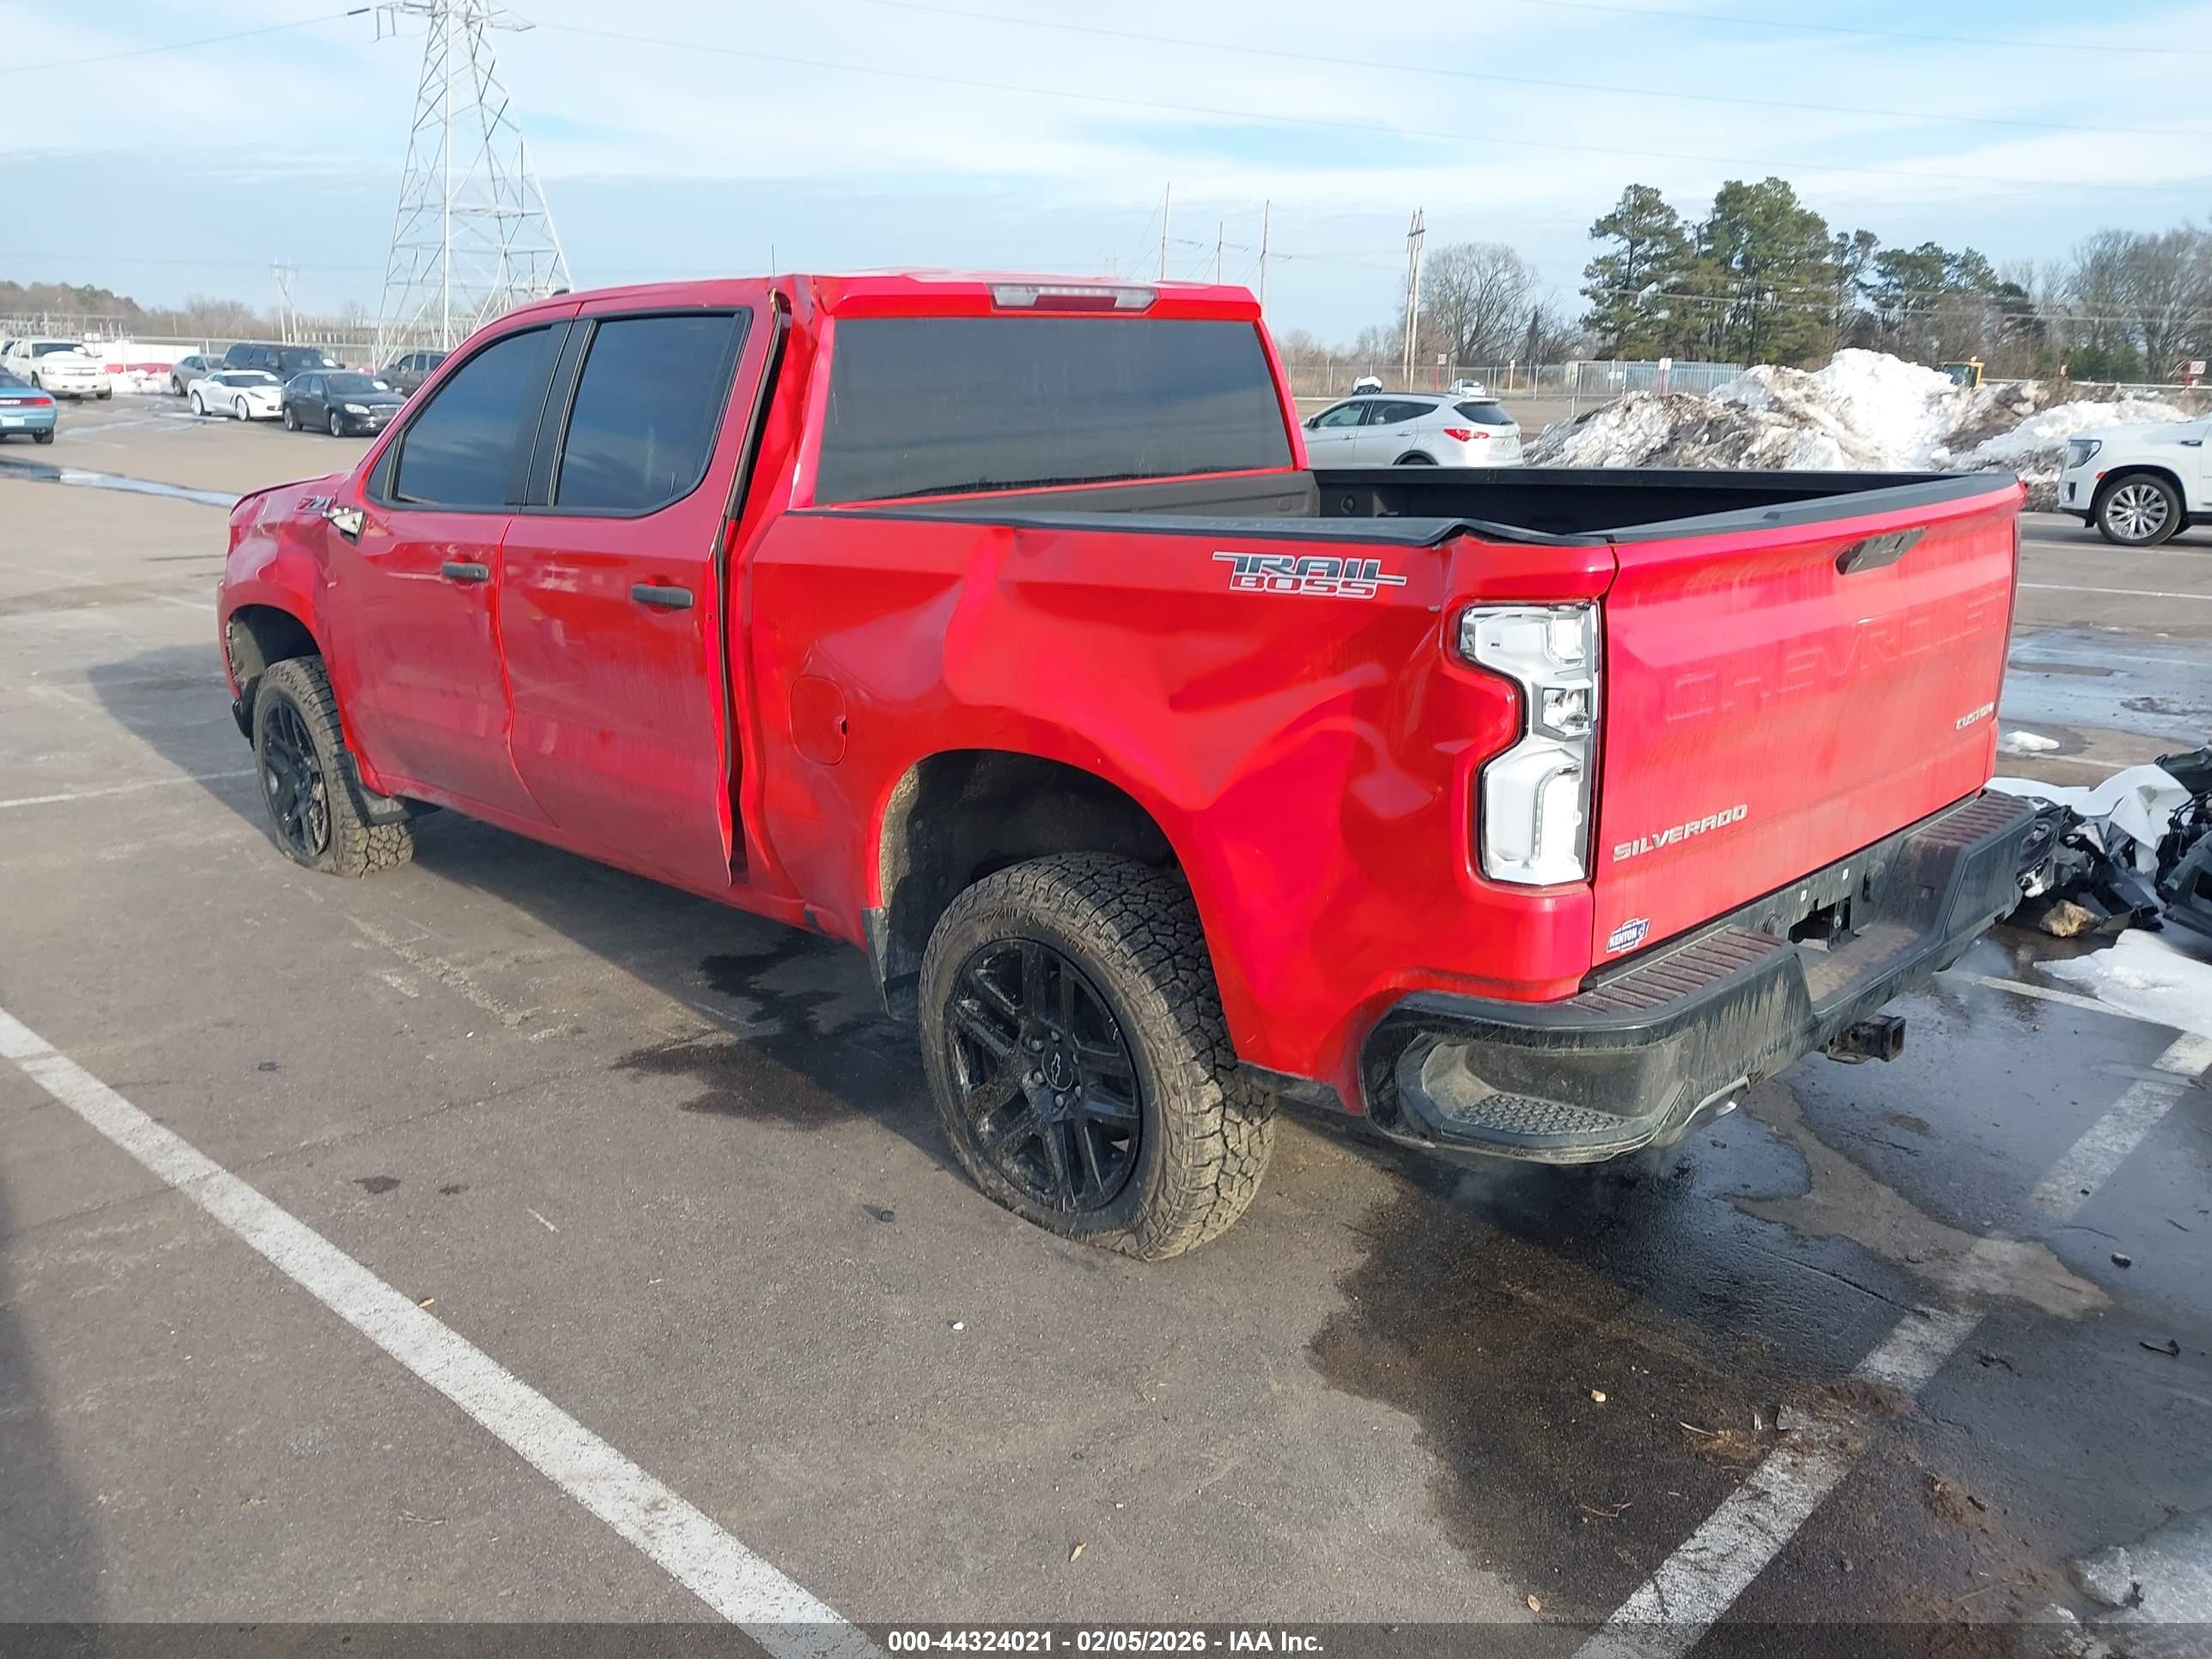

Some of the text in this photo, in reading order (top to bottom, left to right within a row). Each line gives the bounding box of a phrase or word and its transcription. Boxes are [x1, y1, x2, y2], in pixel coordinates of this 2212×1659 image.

[1212, 551, 1407, 586] TRAIL
[1230, 574, 1377, 599] BOSS
[1955, 701, 1994, 730] CUSTOM
[1613, 804, 1748, 862] SILVERADO
[1608, 927, 1638, 948] KENTON
